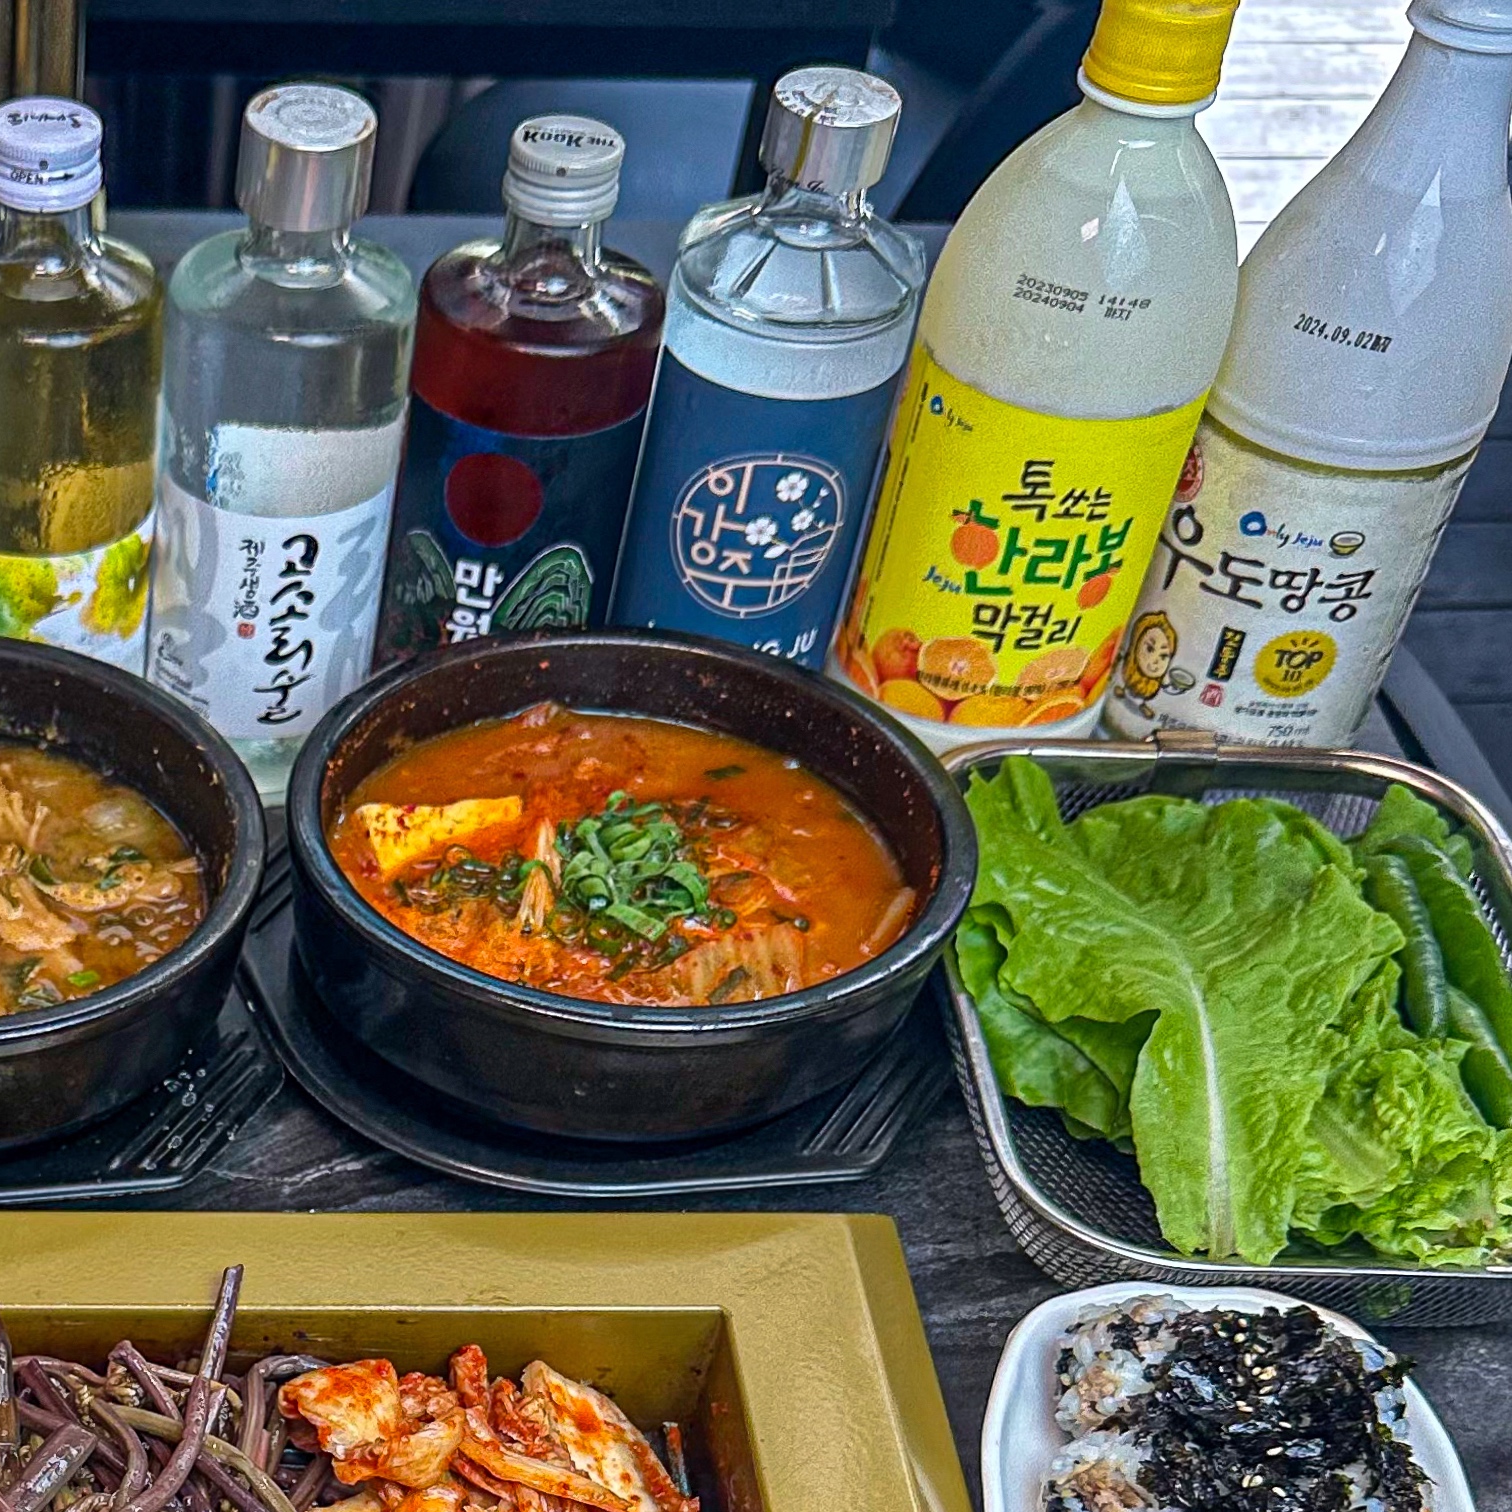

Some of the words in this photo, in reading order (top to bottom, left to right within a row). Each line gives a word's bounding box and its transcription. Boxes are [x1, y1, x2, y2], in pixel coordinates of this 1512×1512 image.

[9, 168, 44, 188] OPEN
[1012, 285, 1085, 316] 20240904
[1016, 272, 1089, 304] 20230905
[952, 500, 1134, 610] 한라봉
[1160, 504, 1380, 624] 우도땅콩
[970, 603, 1083, 656] 막걸리
[1274, 647, 1323, 672] TOP
